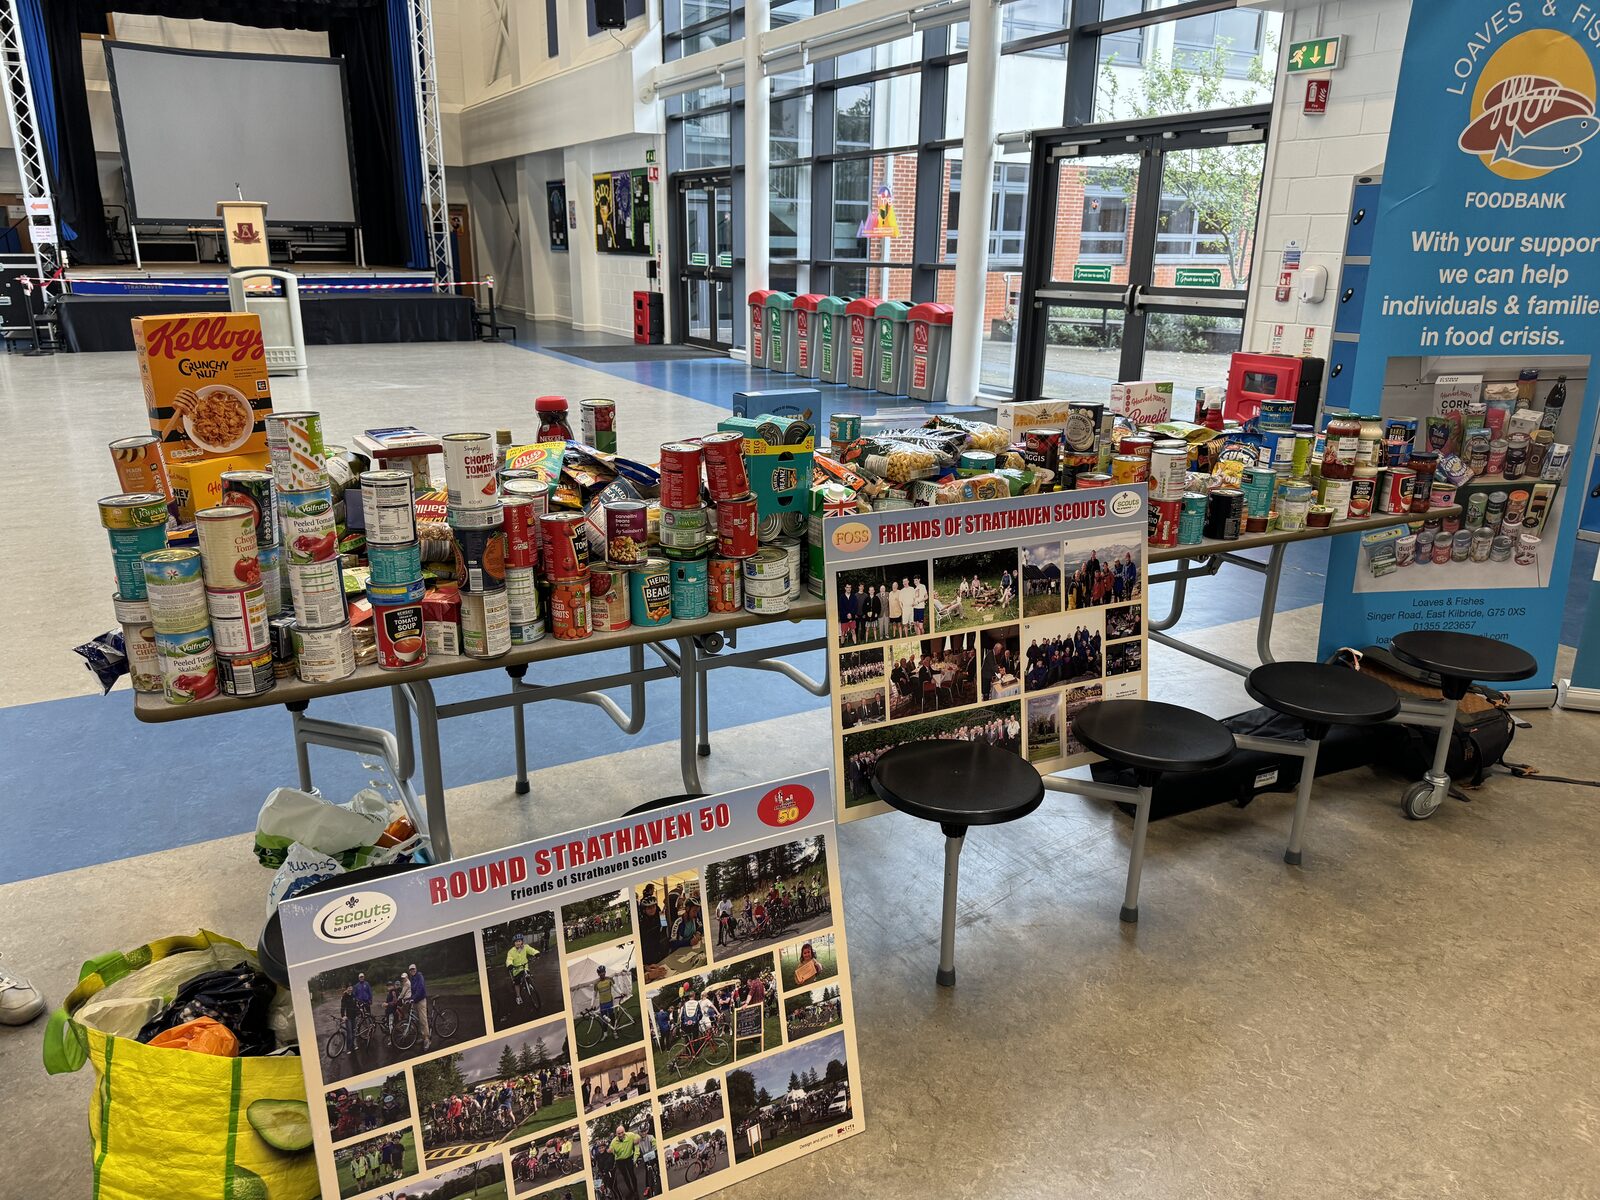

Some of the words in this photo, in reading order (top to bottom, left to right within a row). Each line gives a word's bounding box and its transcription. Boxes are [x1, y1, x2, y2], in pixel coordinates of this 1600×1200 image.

[1446, 2, 1523, 95] LOAVES
[1542, 0, 1557, 17] &
[1572, 3, 1600, 48] FIS
[1465, 192, 1567, 209] FOODBANK
[1412, 231, 1459, 252] With
[1464, 236, 1515, 257] your
[1439, 268, 1468, 284] we
[1474, 268, 1514, 284] can
[1521, 263, 1569, 288] help
[1381, 295, 1497, 316] individuals
[1504, 294, 1520, 315] &
[1420, 327, 1438, 346] in
[1445, 326, 1494, 345] food
[1500, 326, 1565, 345] crisis.
[178, 358, 229, 376] CRUNCHY
[196, 370, 219, 379] NUT
[1441, 400, 1470, 408] CORN
[173, 488, 189, 497] NEY
[176, 498, 187, 507] UT
[302, 502, 329, 512] Valfrutta
[1117, 499, 1140, 508] scouts
[879, 518, 941, 546] FRIENDS
[944, 517, 962, 537] OF
[964, 505, 1051, 535] STRATHAVEN
[1054, 499, 1106, 523] SCOUTS
[835, 530, 869, 546] FOSS
[1413, 598, 1444, 607] Loaves
[1446, 598, 1452, 606] &
[1455, 597, 1485, 606] Fishes
[394, 616, 418, 625] TOMATO
[1367, 612, 1395, 622] Singer
[1427, 609, 1445, 619] East
[1448, 608, 1484, 619] Kilbride,
[1487, 608, 1506, 617] G75
[1508, 607, 1526, 616] 0XS
[398, 622, 417, 631] SOUP
[1413, 621, 1440, 630] 01355
[1443, 620, 1476, 630] 223657
[136, 648, 157, 656] CHIC
[182, 640, 212, 653] Valfrutta
[173, 659, 196, 667] Peeled
[178, 665, 201, 673] Skalade
[777, 807, 800, 825] 50
[428, 856, 528, 906] ROUND
[535, 811, 694, 877] STRATHAVEN
[699, 803, 731, 833] 50
[511, 881, 554, 901] Friends
[557, 876, 568, 887] of
[570, 860, 630, 883] Strathaven
[632, 850, 668, 867] Scouts
[334, 903, 392, 927] scouts
[344, 918, 372, 932] prepared
